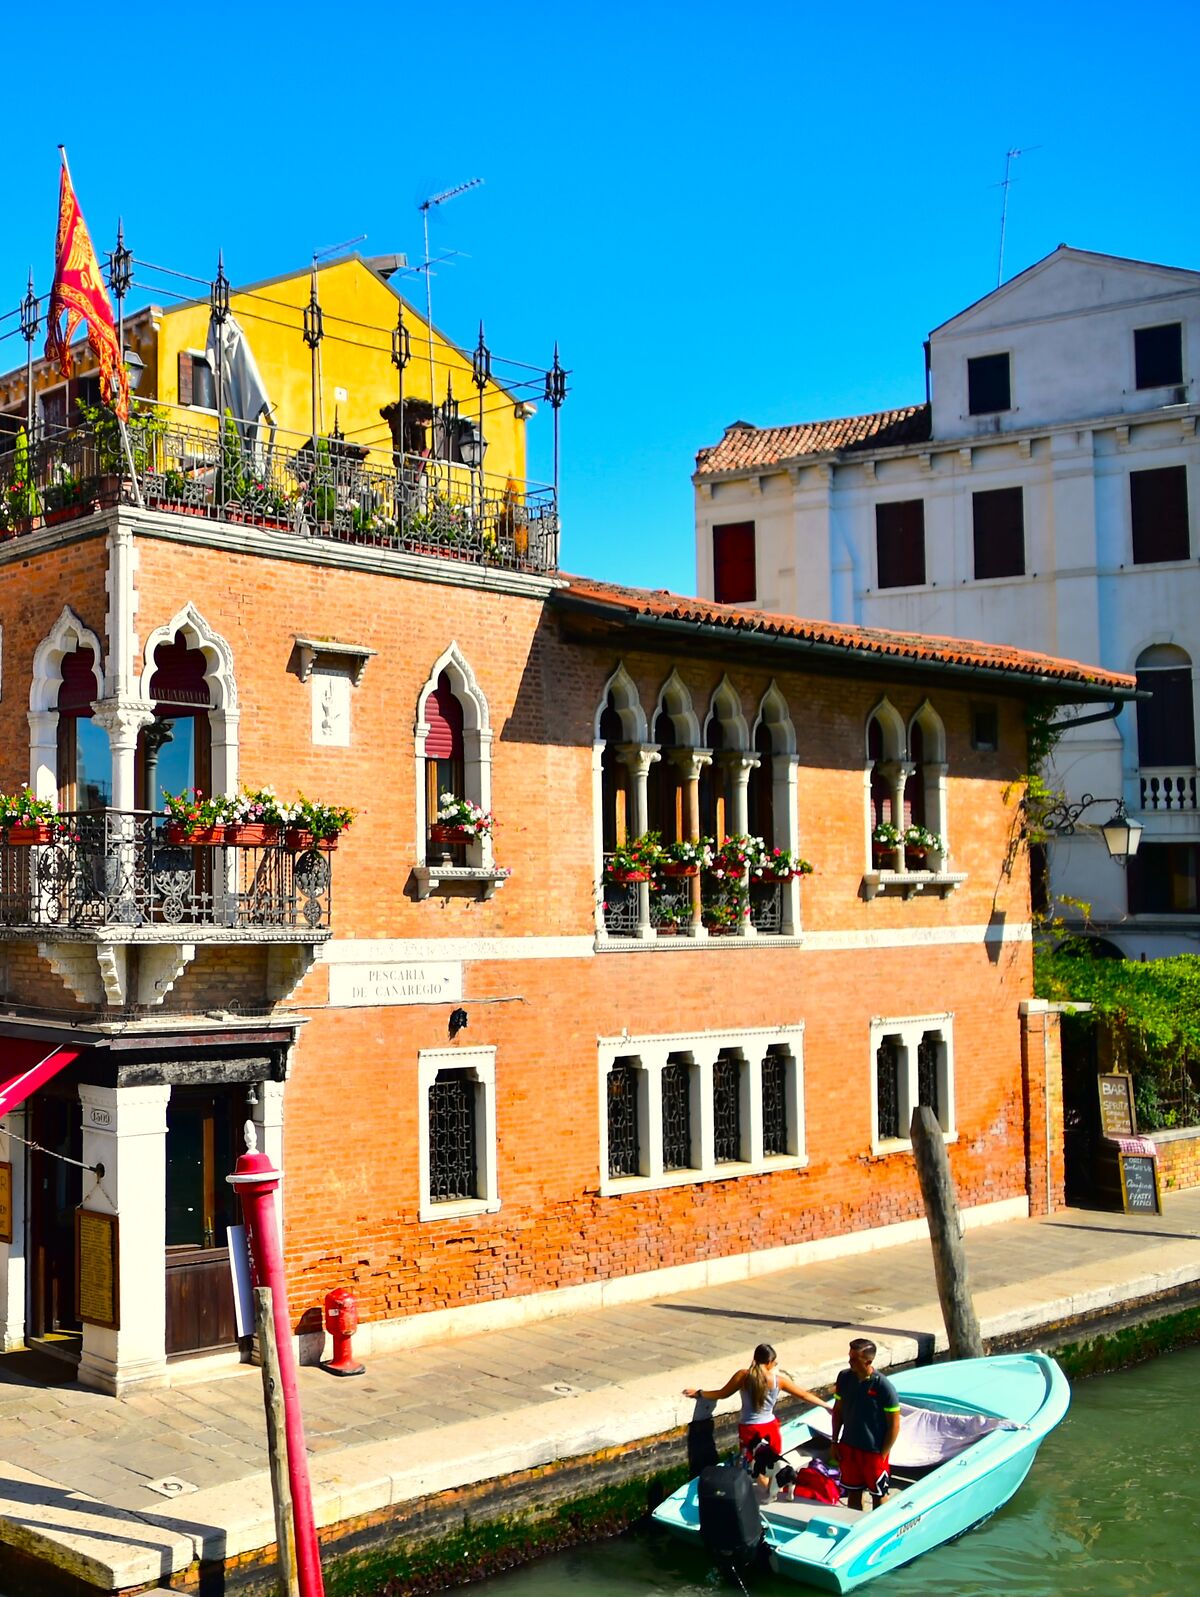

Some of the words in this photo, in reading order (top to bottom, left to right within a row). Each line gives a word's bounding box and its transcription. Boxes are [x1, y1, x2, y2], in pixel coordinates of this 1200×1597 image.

[369, 969, 425, 982] PESCARIA
[352, 987, 367, 998] DE
[375, 984, 442, 997] CANAREGIO
[1102, 1082, 1126, 1096] BAR
